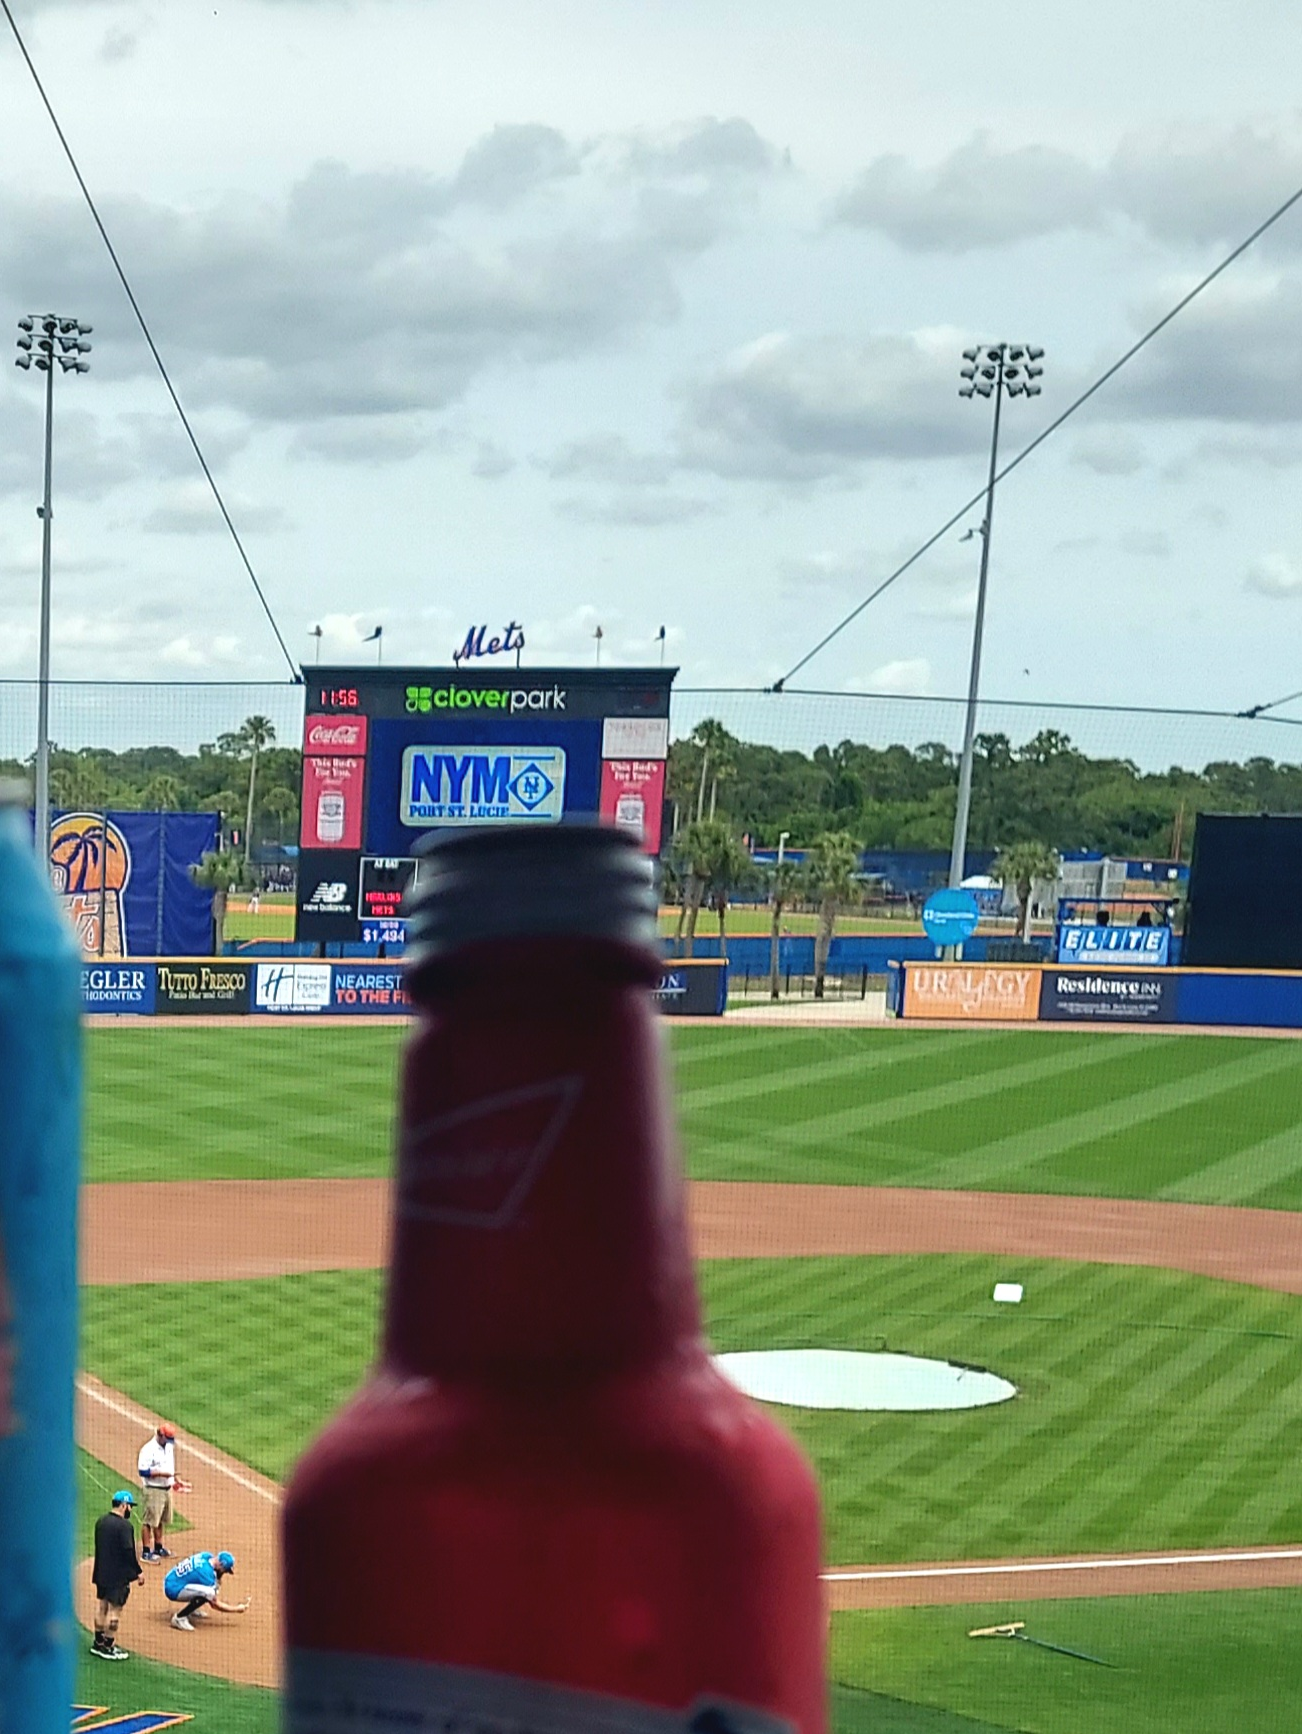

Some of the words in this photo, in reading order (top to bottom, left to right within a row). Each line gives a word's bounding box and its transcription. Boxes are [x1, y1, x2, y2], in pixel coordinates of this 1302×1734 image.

[453, 621, 525, 660] Mets
[321, 689, 358, 706] 11:56
[411, 754, 511, 804] NYM
[409, 805, 445, 817] PORT
[448, 806, 467, 817] ST.
[469, 806, 509, 817] LUCIE
[303, 903, 318, 911] new
[319, 903, 352, 912] balance
[1065, 931, 1162, 950] ELITE
[158, 967, 197, 991] TUTTO
[200, 967, 246, 991] FRESCO
[335, 974, 403, 989] NEAREST
[1057, 976, 1139, 994] Residence
[335, 990, 357, 1004] TO
[360, 990, 389, 1004] THE
